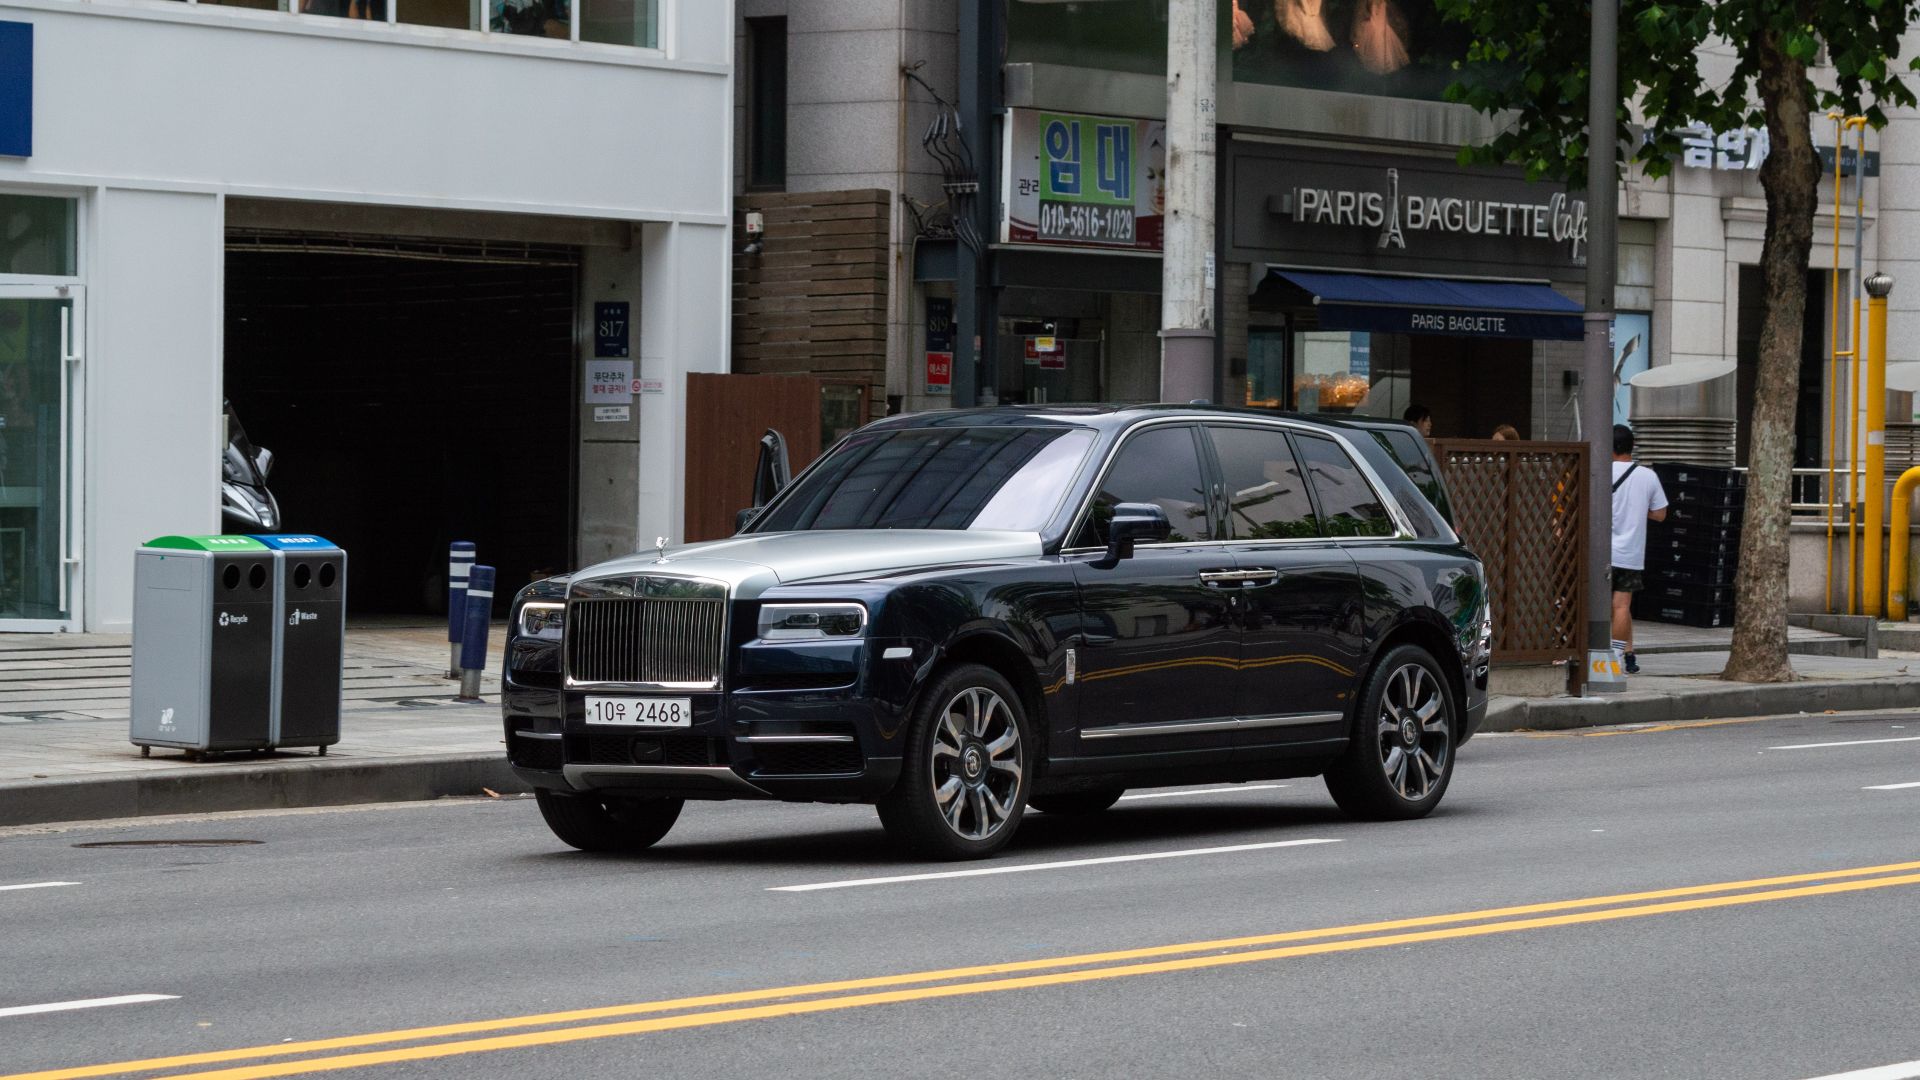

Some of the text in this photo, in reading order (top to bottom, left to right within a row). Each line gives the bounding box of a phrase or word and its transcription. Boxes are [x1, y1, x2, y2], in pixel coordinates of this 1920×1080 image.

[1041, 203, 1133, 240] 010-5616-1029
[1299, 187, 1384, 228] PARIS
[1406, 194, 1549, 238] BAGUETTE
[599, 320, 625, 337] 817
[1411, 313, 1506, 333] PARIS BAGUETTE
[230, 614, 248, 625] Recycle
[301, 611, 318, 621] Waste
[594, 701, 680, 723] 10우 2468
